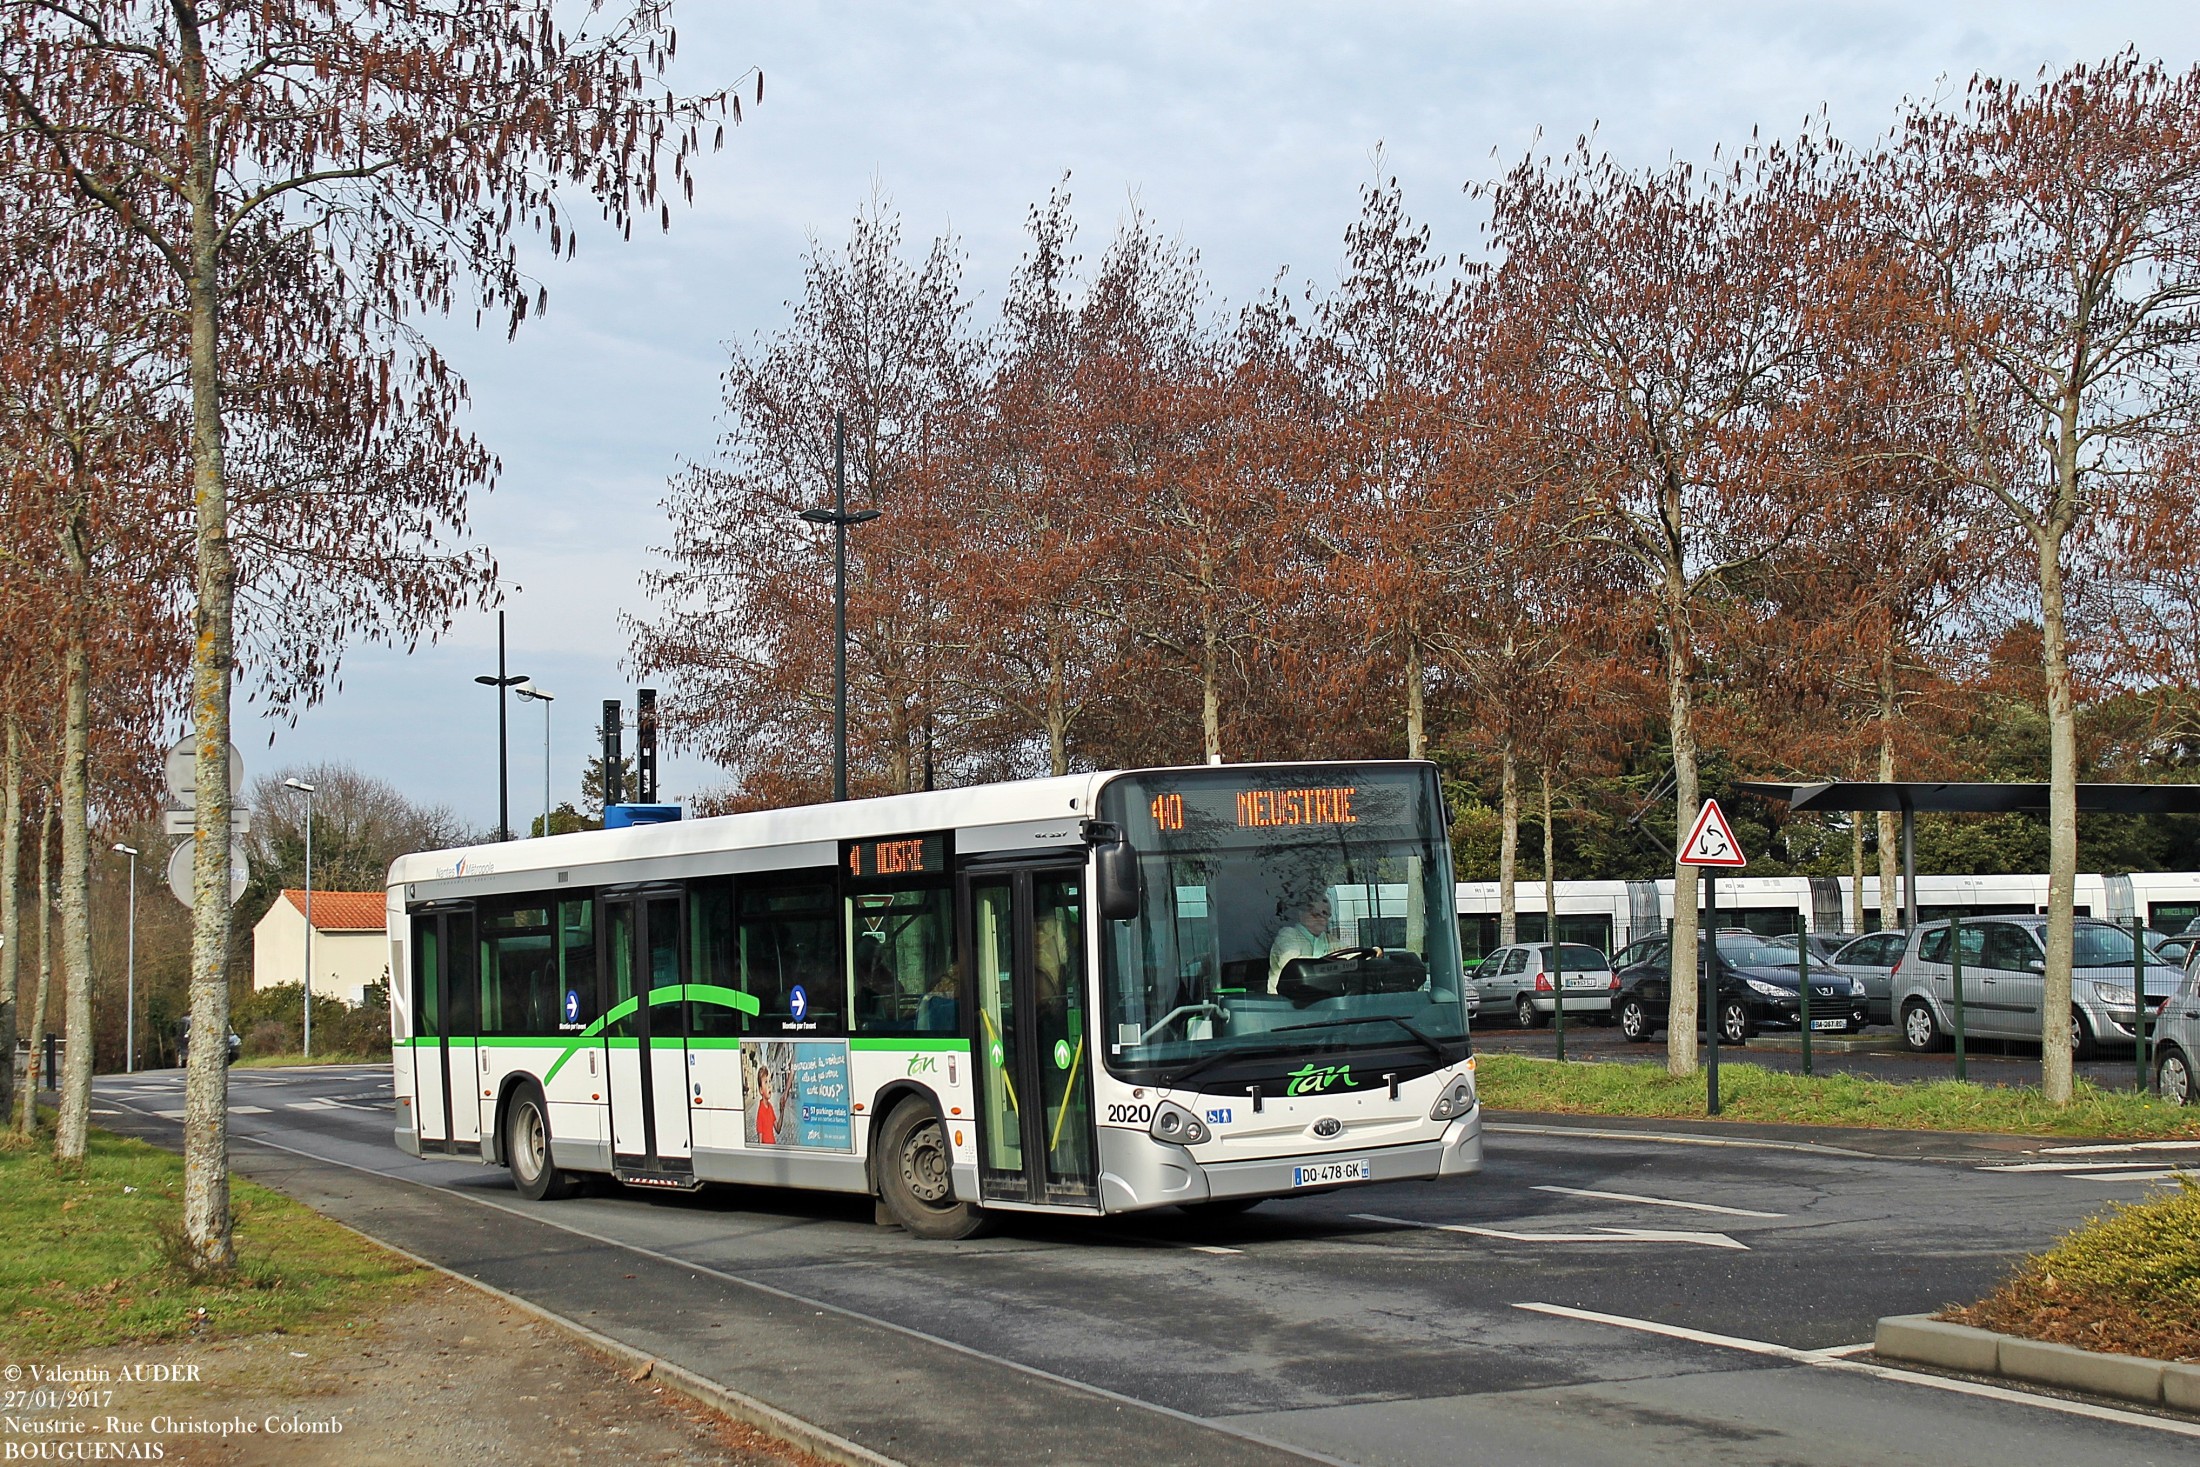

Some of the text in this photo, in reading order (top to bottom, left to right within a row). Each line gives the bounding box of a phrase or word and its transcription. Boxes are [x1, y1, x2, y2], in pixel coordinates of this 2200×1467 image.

[1152, 787, 1358, 830] 40 NEUSTRIE
[436, 861, 495, 879] Nantes Métropole
[907, 1053, 938, 1076] tan
[1287, 1064, 1358, 1096] tan
[1108, 1104, 1151, 1123] 2020
